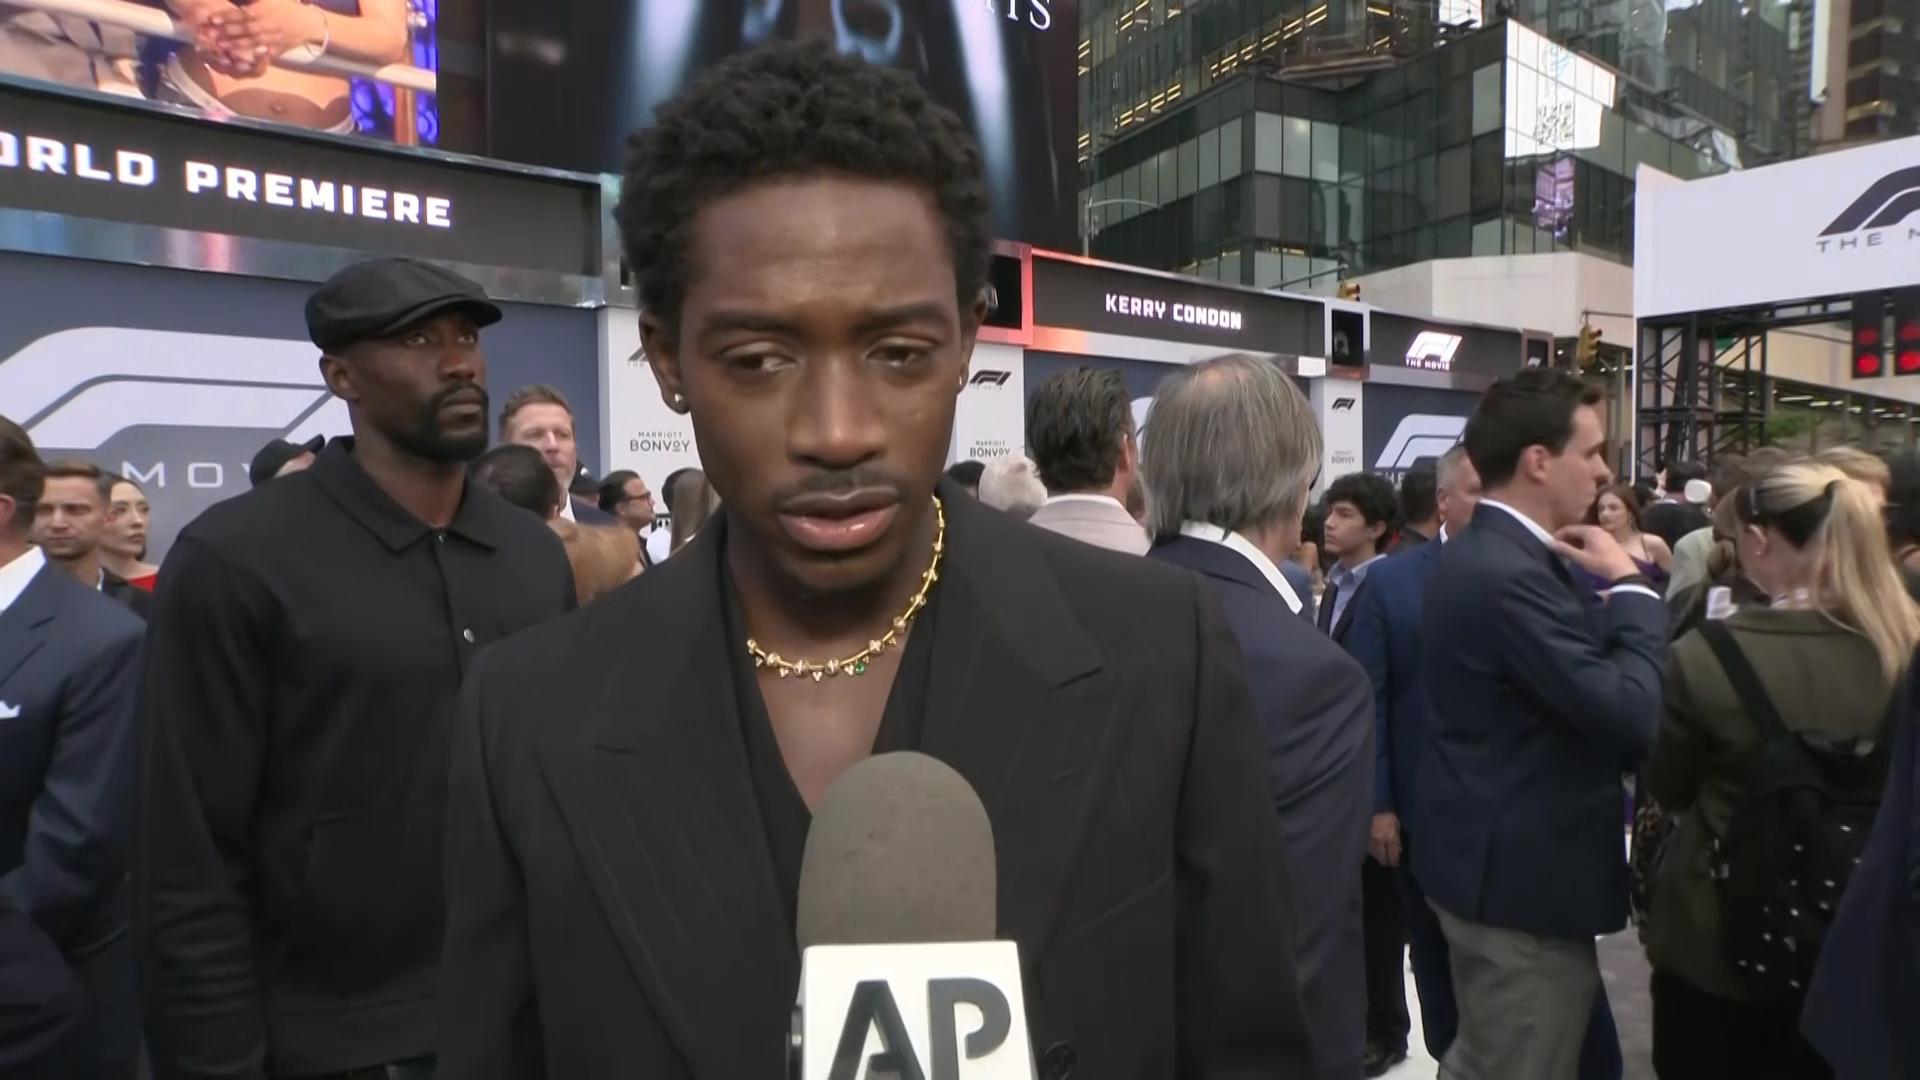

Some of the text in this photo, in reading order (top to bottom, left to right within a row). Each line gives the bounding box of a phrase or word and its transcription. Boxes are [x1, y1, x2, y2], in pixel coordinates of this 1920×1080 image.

[185, 160, 451, 228] PREMIERE
[1816, 231, 1883, 253] THE
[1105, 293, 1242, 330] KERRY CONDON
[1406, 359, 1451, 371] THE MOVIE
[630, 439, 691, 452] BONVOY
[826, 976, 991, 1080] AP
